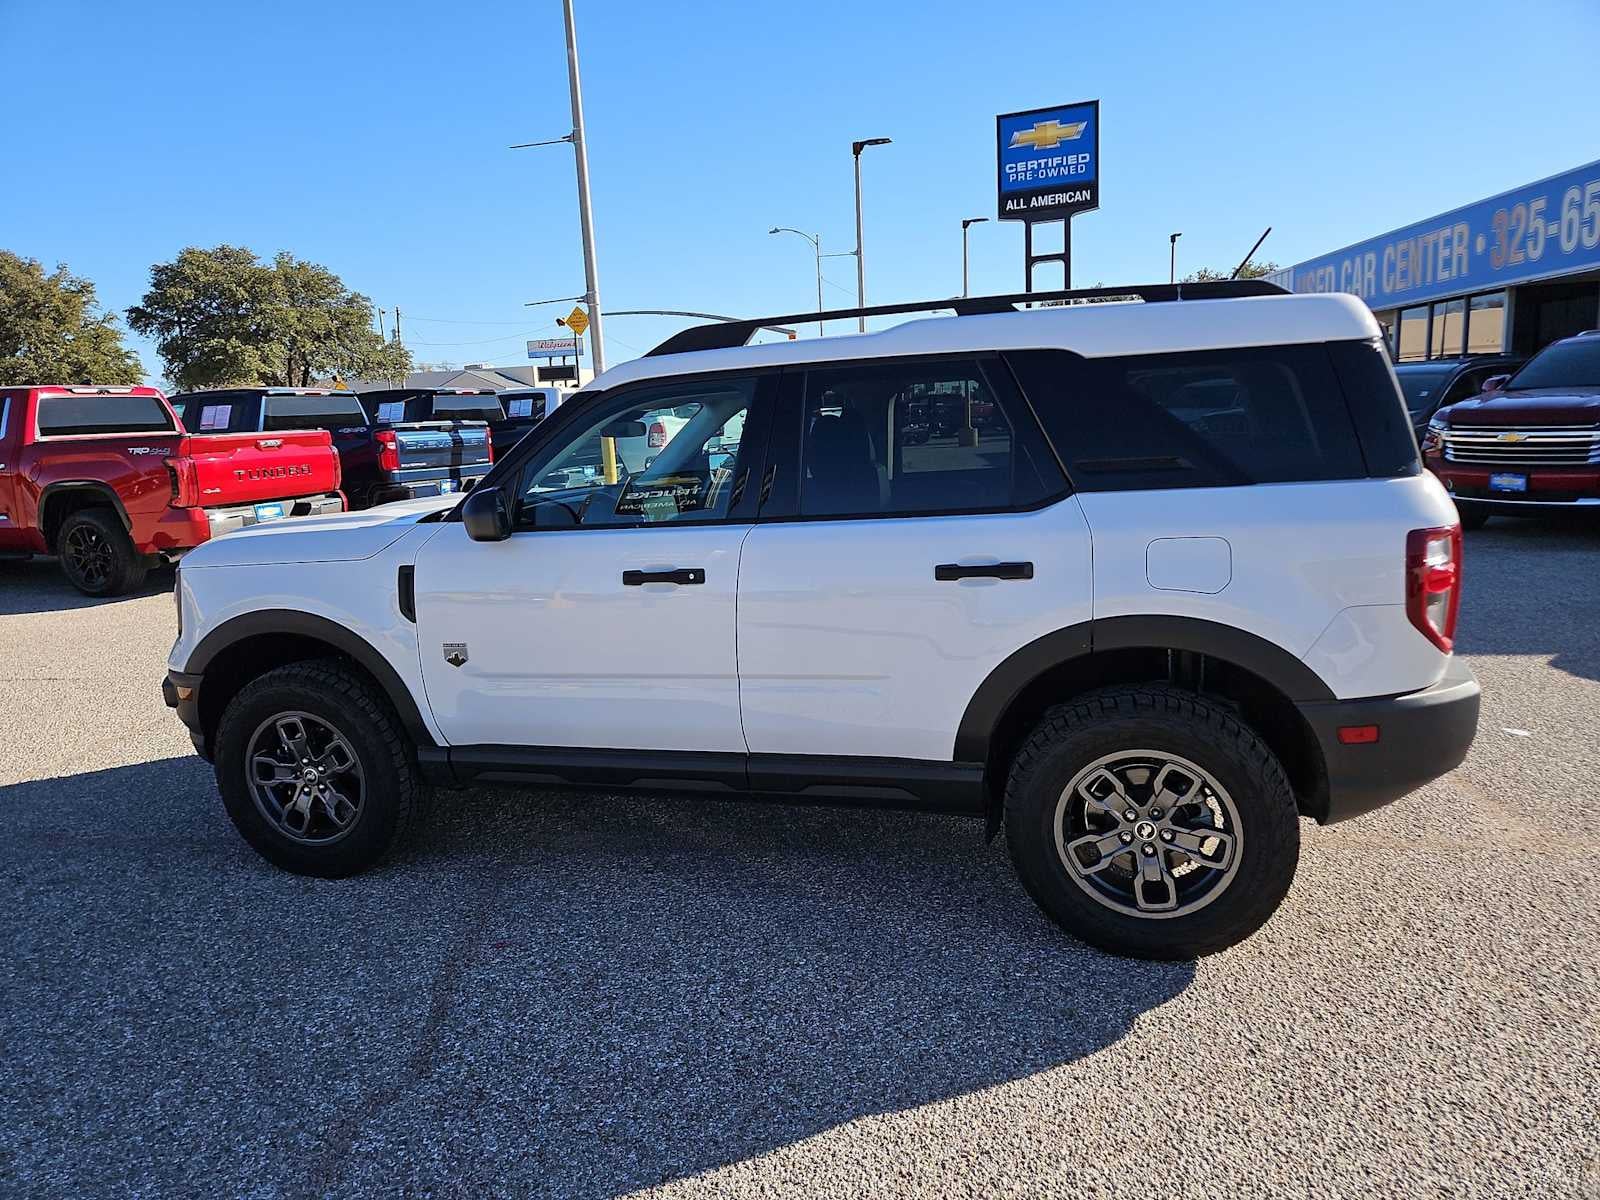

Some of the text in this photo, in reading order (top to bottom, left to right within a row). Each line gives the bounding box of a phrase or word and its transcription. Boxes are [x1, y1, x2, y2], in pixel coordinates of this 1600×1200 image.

[1005, 153, 1090, 173] CERTIFIED
[1009, 164, 1086, 182] PRE-OWNED
[1006, 189, 1091, 211] ALL AMERICAN
[1340, 252, 1377, 298] CAR
[1382, 222, 1471, 294] CENTER
[1490, 178, 1600, 270] 325-65
[233, 464, 312, 482] TUNDRA
